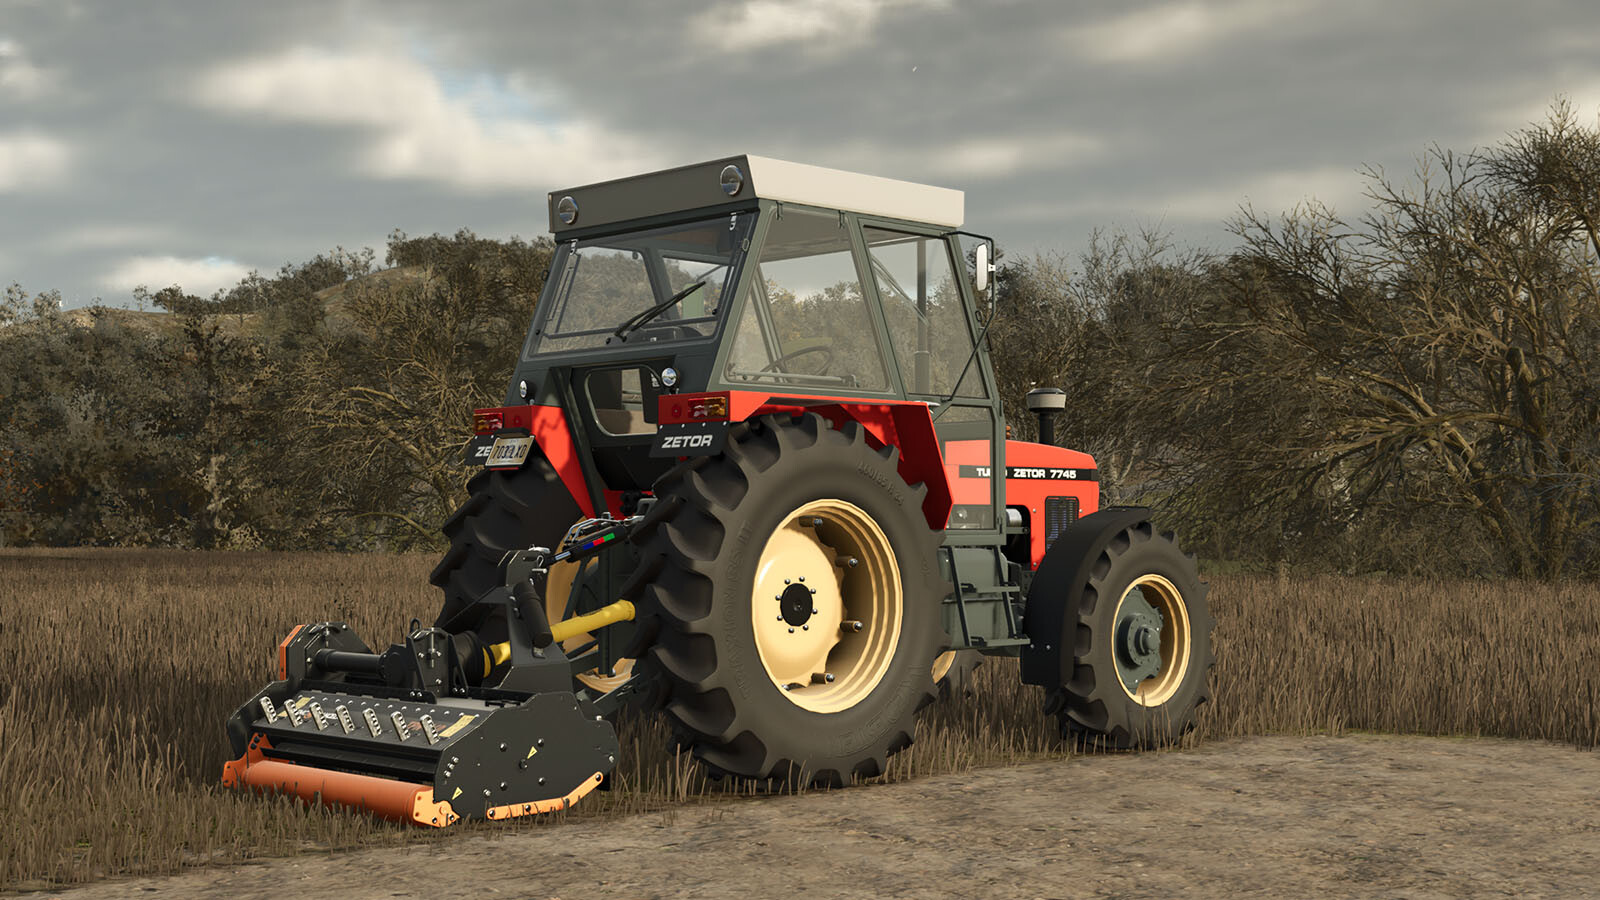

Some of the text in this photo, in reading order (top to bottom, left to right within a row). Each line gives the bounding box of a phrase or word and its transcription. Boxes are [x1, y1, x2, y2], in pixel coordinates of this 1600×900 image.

[661, 434, 713, 449] ZETOR
[1013, 467, 1046, 479] ZETOR
[1049, 469, 1077, 479] 7745
